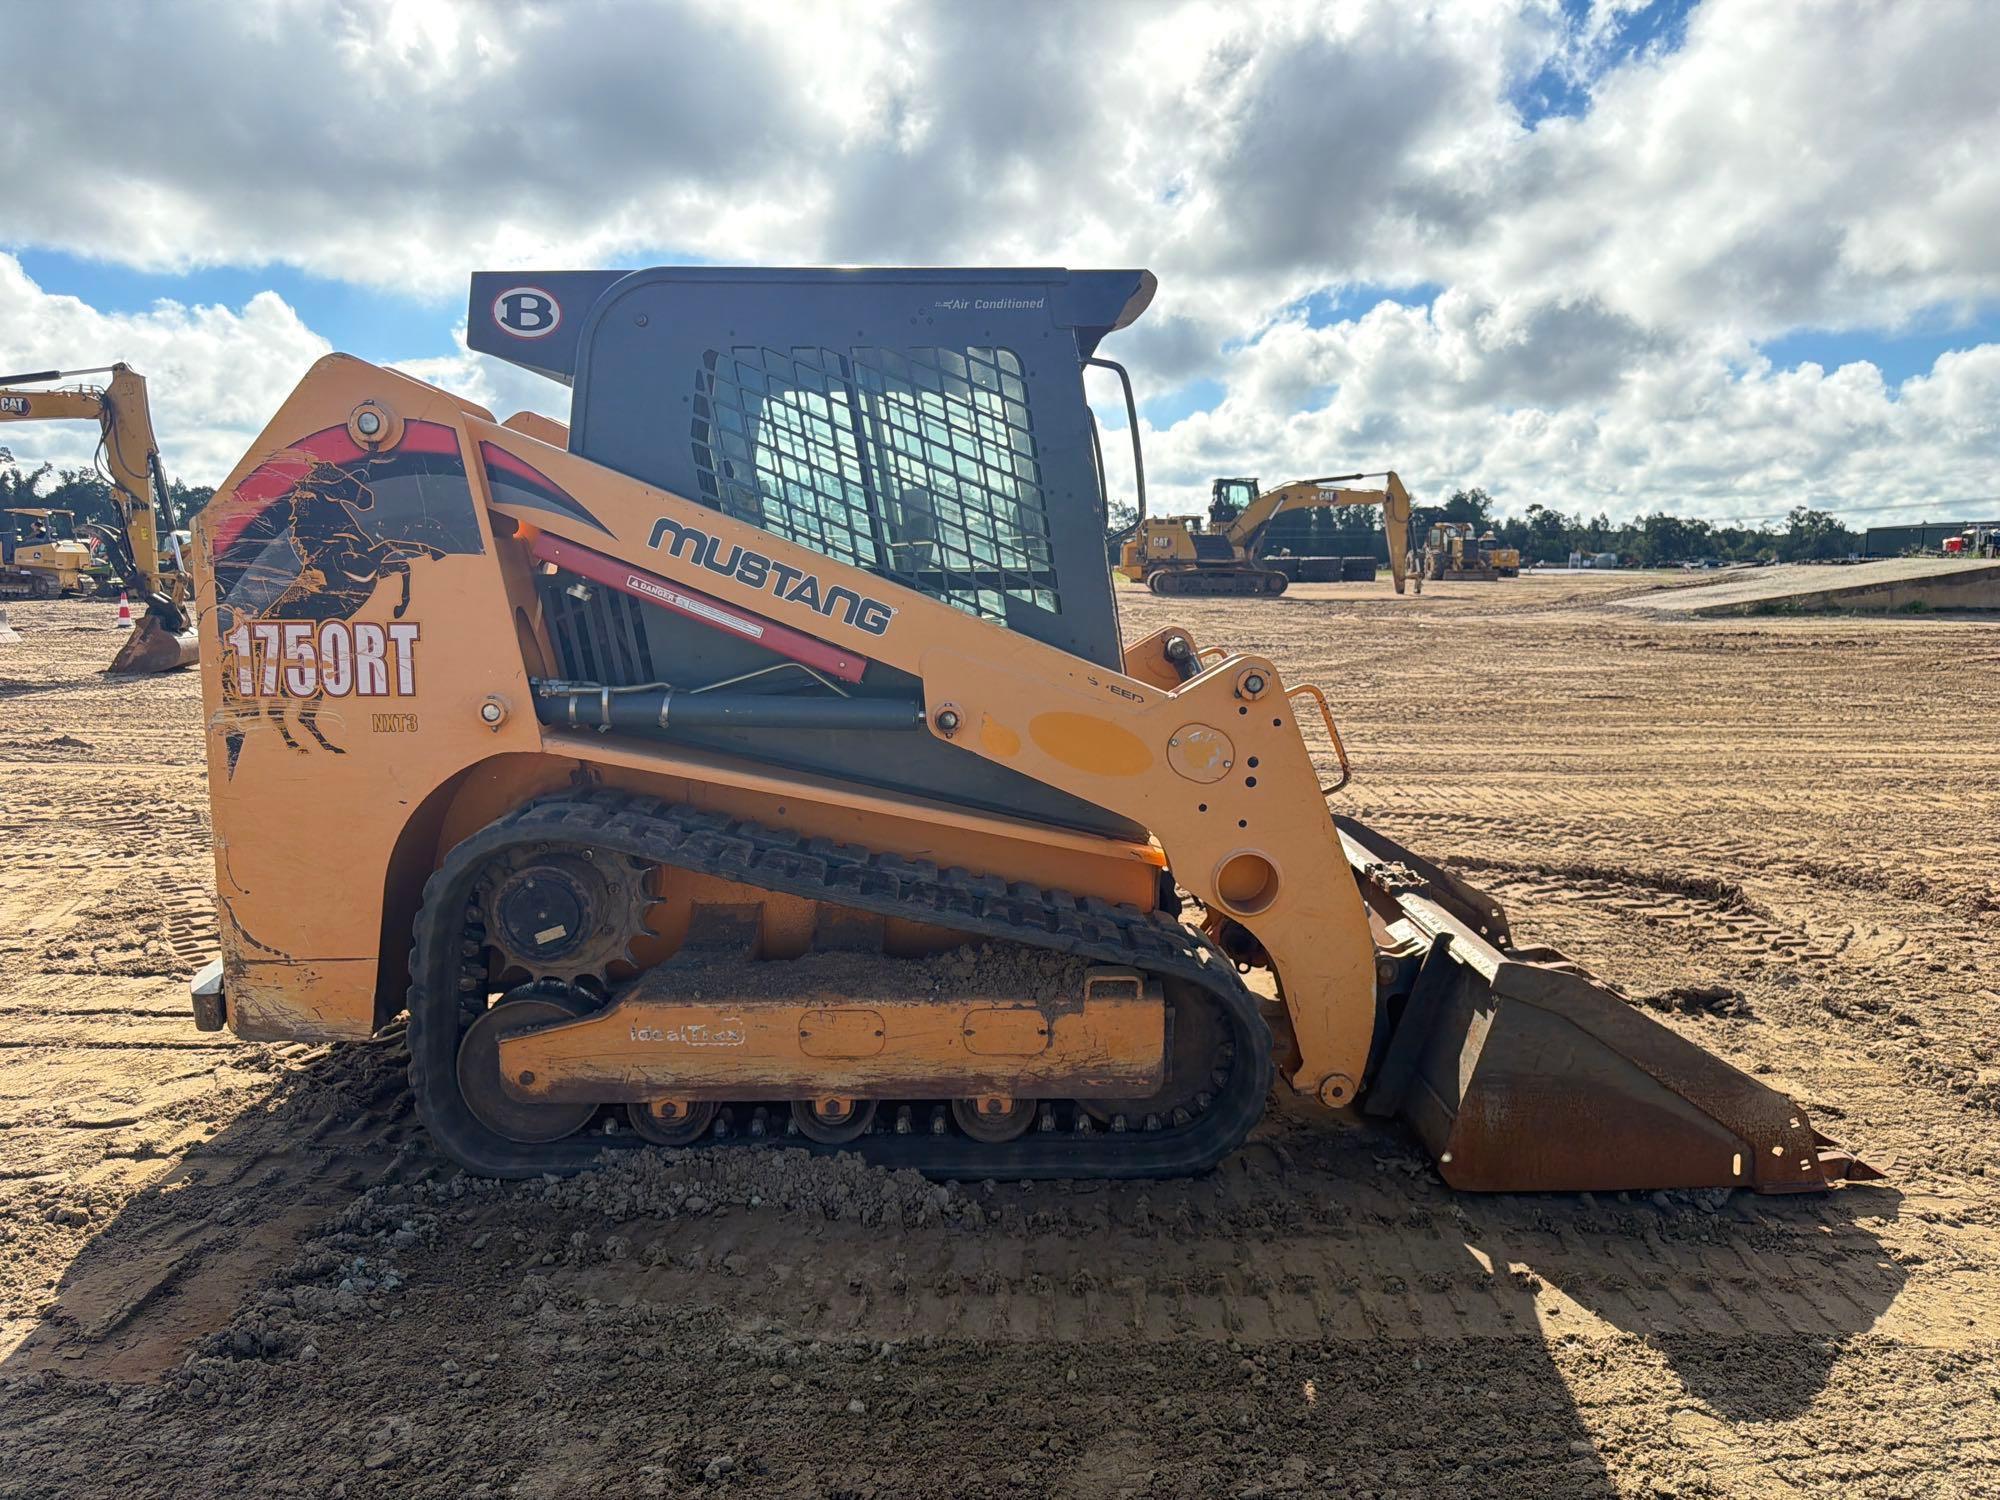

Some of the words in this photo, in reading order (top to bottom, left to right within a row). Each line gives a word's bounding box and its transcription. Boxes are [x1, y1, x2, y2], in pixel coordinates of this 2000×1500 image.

[952, 299, 969, 309] Air
[974, 298, 1044, 309] Conditioned
[0, 397, 24, 412] CAT
[1319, 491, 1335, 501] CAT
[1153, 536, 1169, 547] CAT
[640, 582, 675, 601] DANGER
[225, 620, 421, 698] 1750RT
[372, 713, 419, 733] NXT3
